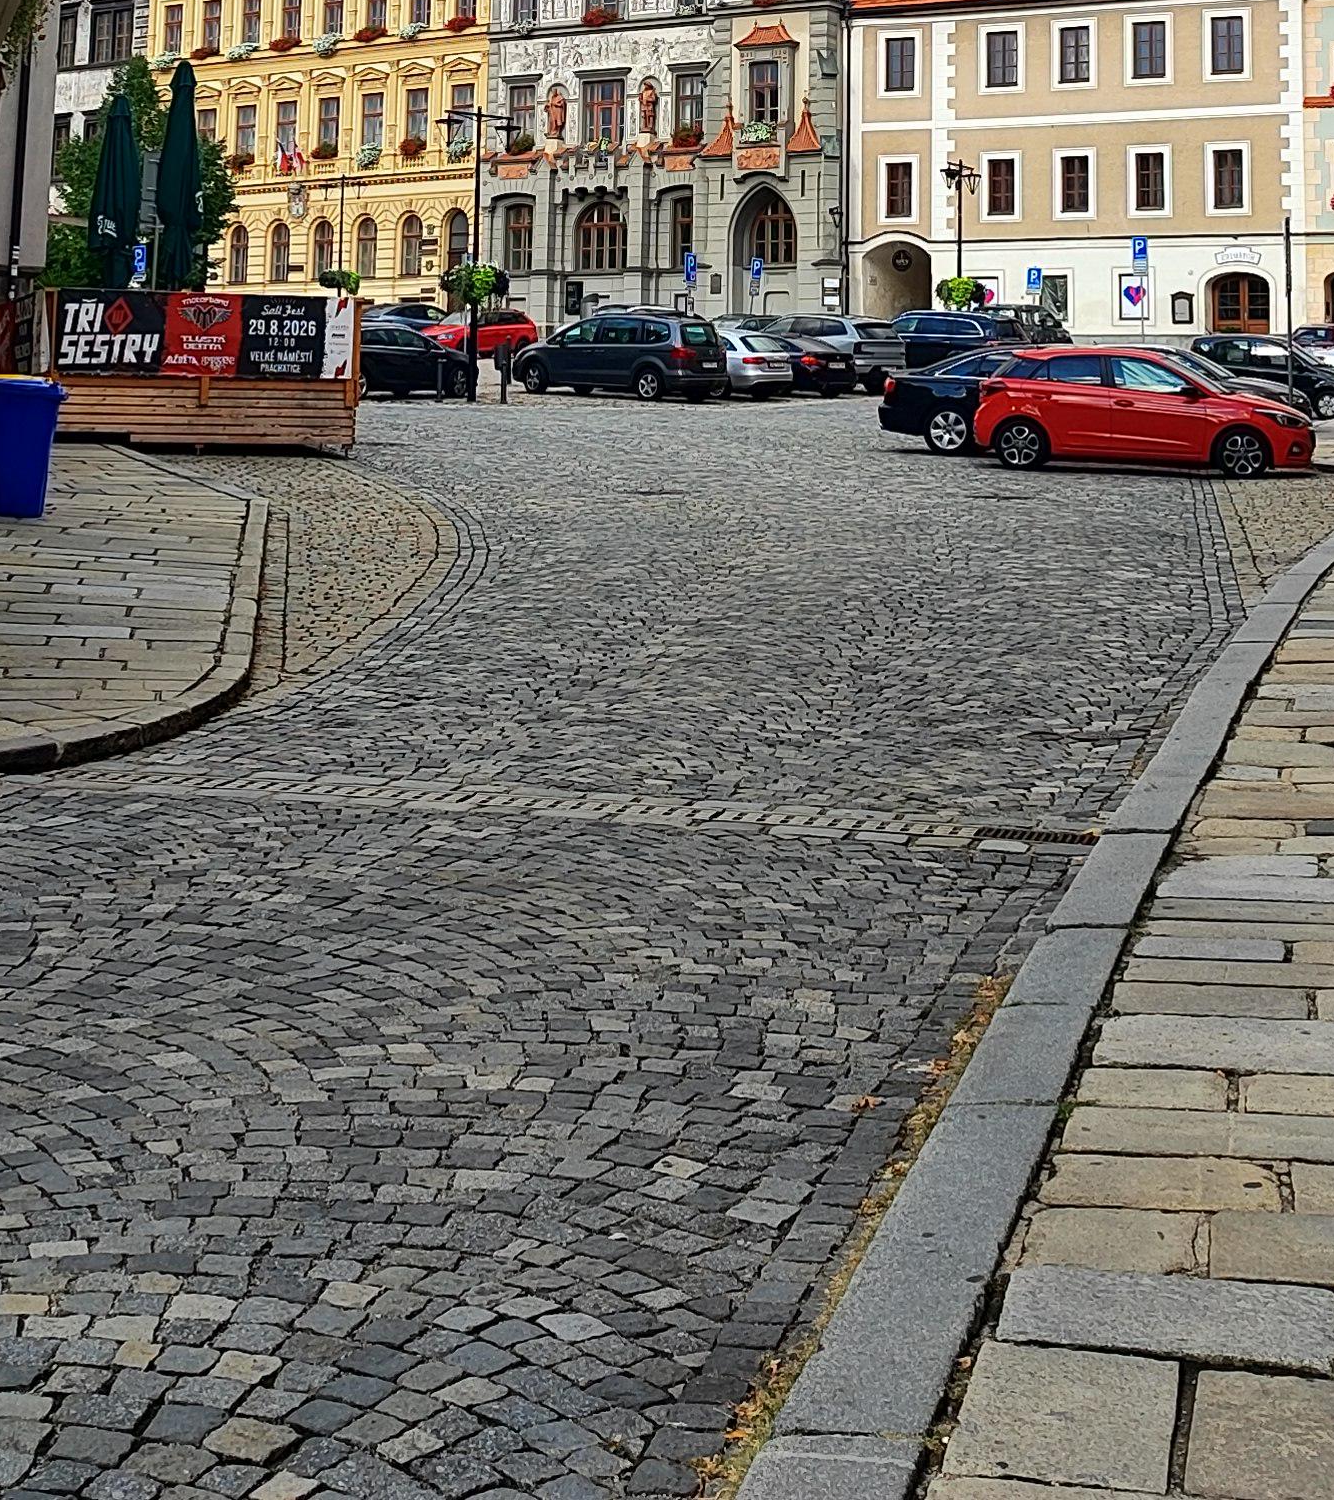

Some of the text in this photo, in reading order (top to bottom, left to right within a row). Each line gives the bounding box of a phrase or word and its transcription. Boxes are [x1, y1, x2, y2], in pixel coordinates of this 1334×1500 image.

[64, 298, 104, 333] TŘI
[249, 319, 317, 337] 29.8.2026
[58, 334, 160, 365] SESTRY
[268, 337, 295, 347] 12:00
[250, 350, 313, 363] VELKÉ NÁMĚSTÍ
[260, 363, 301, 373] PRACHATICE
